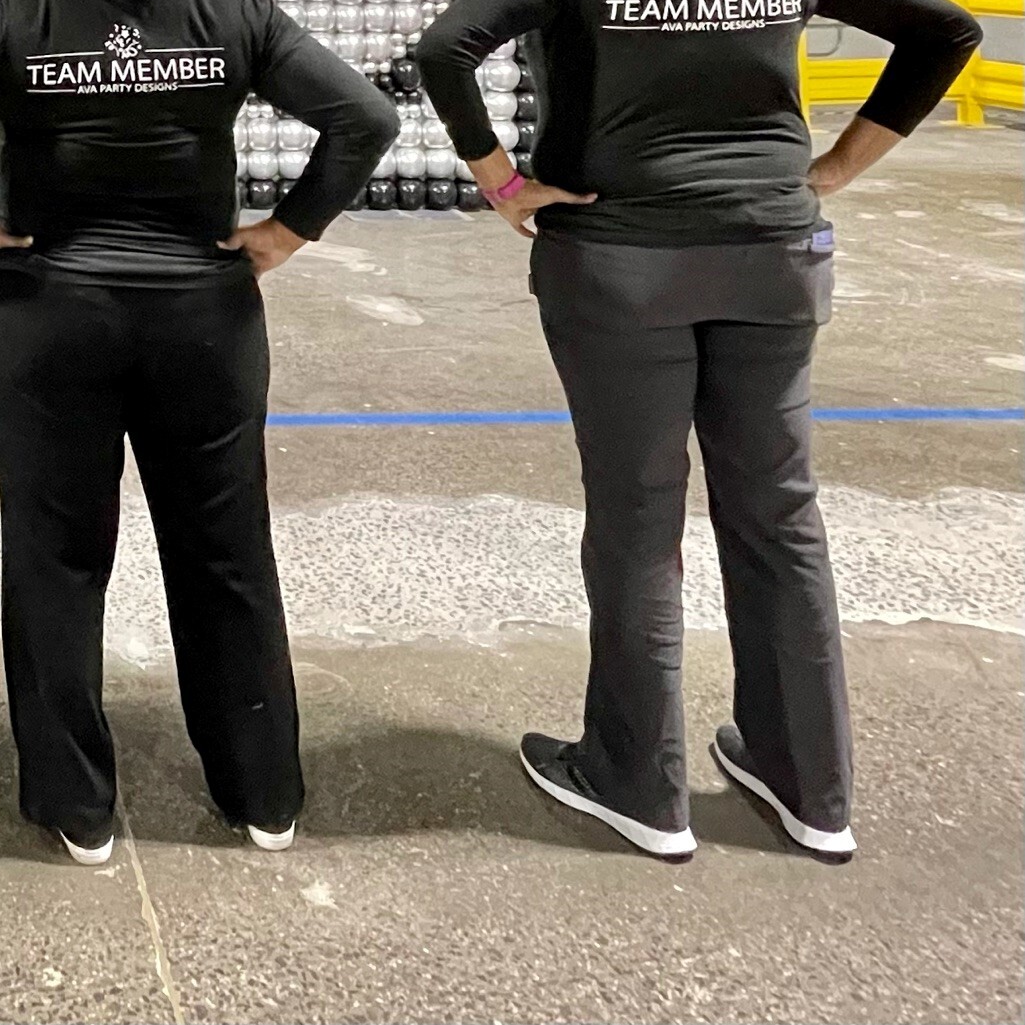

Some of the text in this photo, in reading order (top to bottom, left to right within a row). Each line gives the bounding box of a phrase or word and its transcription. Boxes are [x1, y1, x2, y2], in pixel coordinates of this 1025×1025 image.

[660, 18, 766, 32] AVA PARTY DESIGNS
[26, 57, 225, 85] TEAM MEMBER
[77, 81, 179, 94] AVA PARTY DESIGNS
